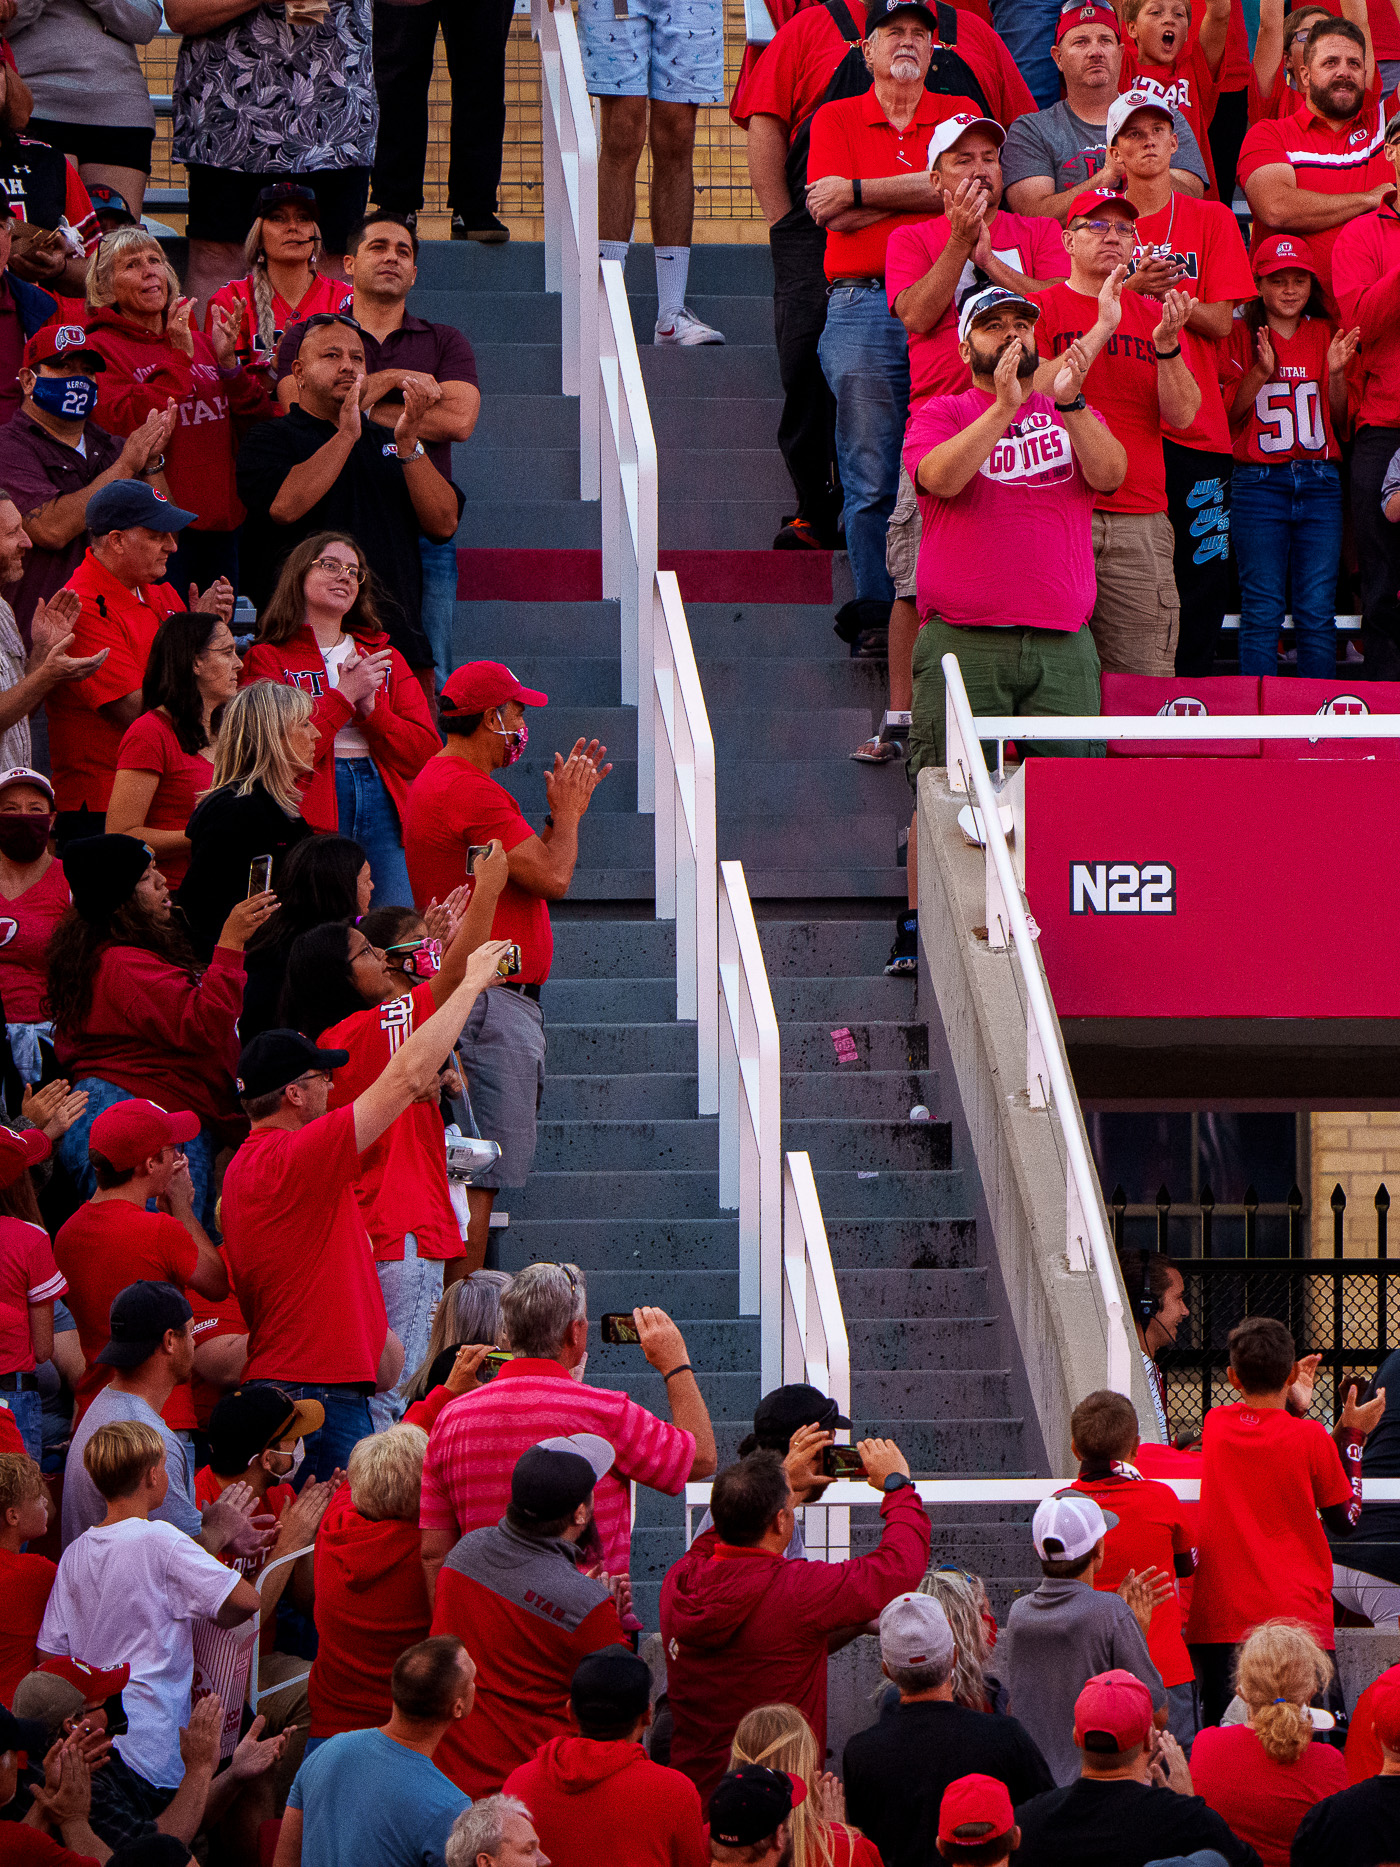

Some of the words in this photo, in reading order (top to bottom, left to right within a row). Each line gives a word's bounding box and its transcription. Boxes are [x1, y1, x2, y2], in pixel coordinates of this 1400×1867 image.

[1106, 334, 1157, 367] UTES
[61, 390, 89, 415] 22
[180, 396, 230, 427] TAH
[1033, 415, 1048, 428] U
[1256, 381, 1326, 454] 50
[990, 443, 1014, 474] GO
[1019, 430, 1064, 471] UTES
[1192, 478, 1221, 496] NIKE
[1213, 490, 1225, 504] SB
[1197, 506, 1223, 524] NIKE
[1217, 517, 1230, 532] SB
[1200, 533, 1229, 551] NIKE
[1073, 865, 1173, 912] N22
[523, 1589, 567, 1621] UTAH
